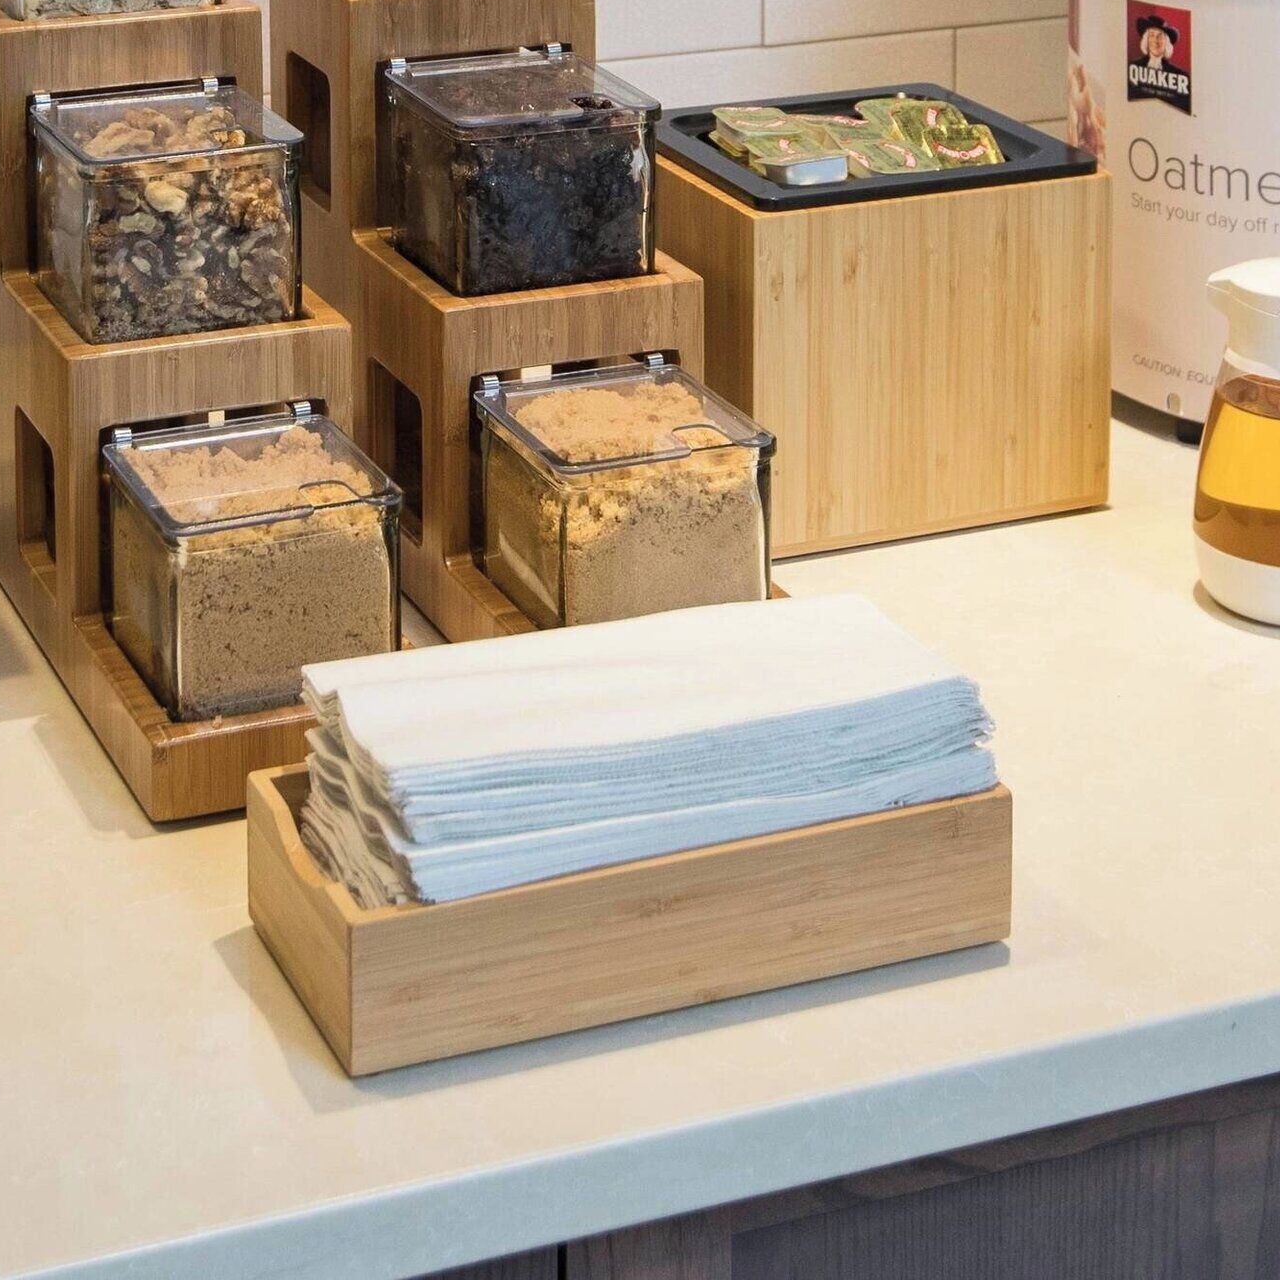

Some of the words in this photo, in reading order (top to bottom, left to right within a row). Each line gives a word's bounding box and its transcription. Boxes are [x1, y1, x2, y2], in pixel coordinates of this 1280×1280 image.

[1128, 64, 1189, 95] QUAKER
[1131, 192, 1162, 215] Start
[1166, 205, 1201, 222] your
[1206, 210, 1239, 233] day
[1244, 216, 1269, 233] off
